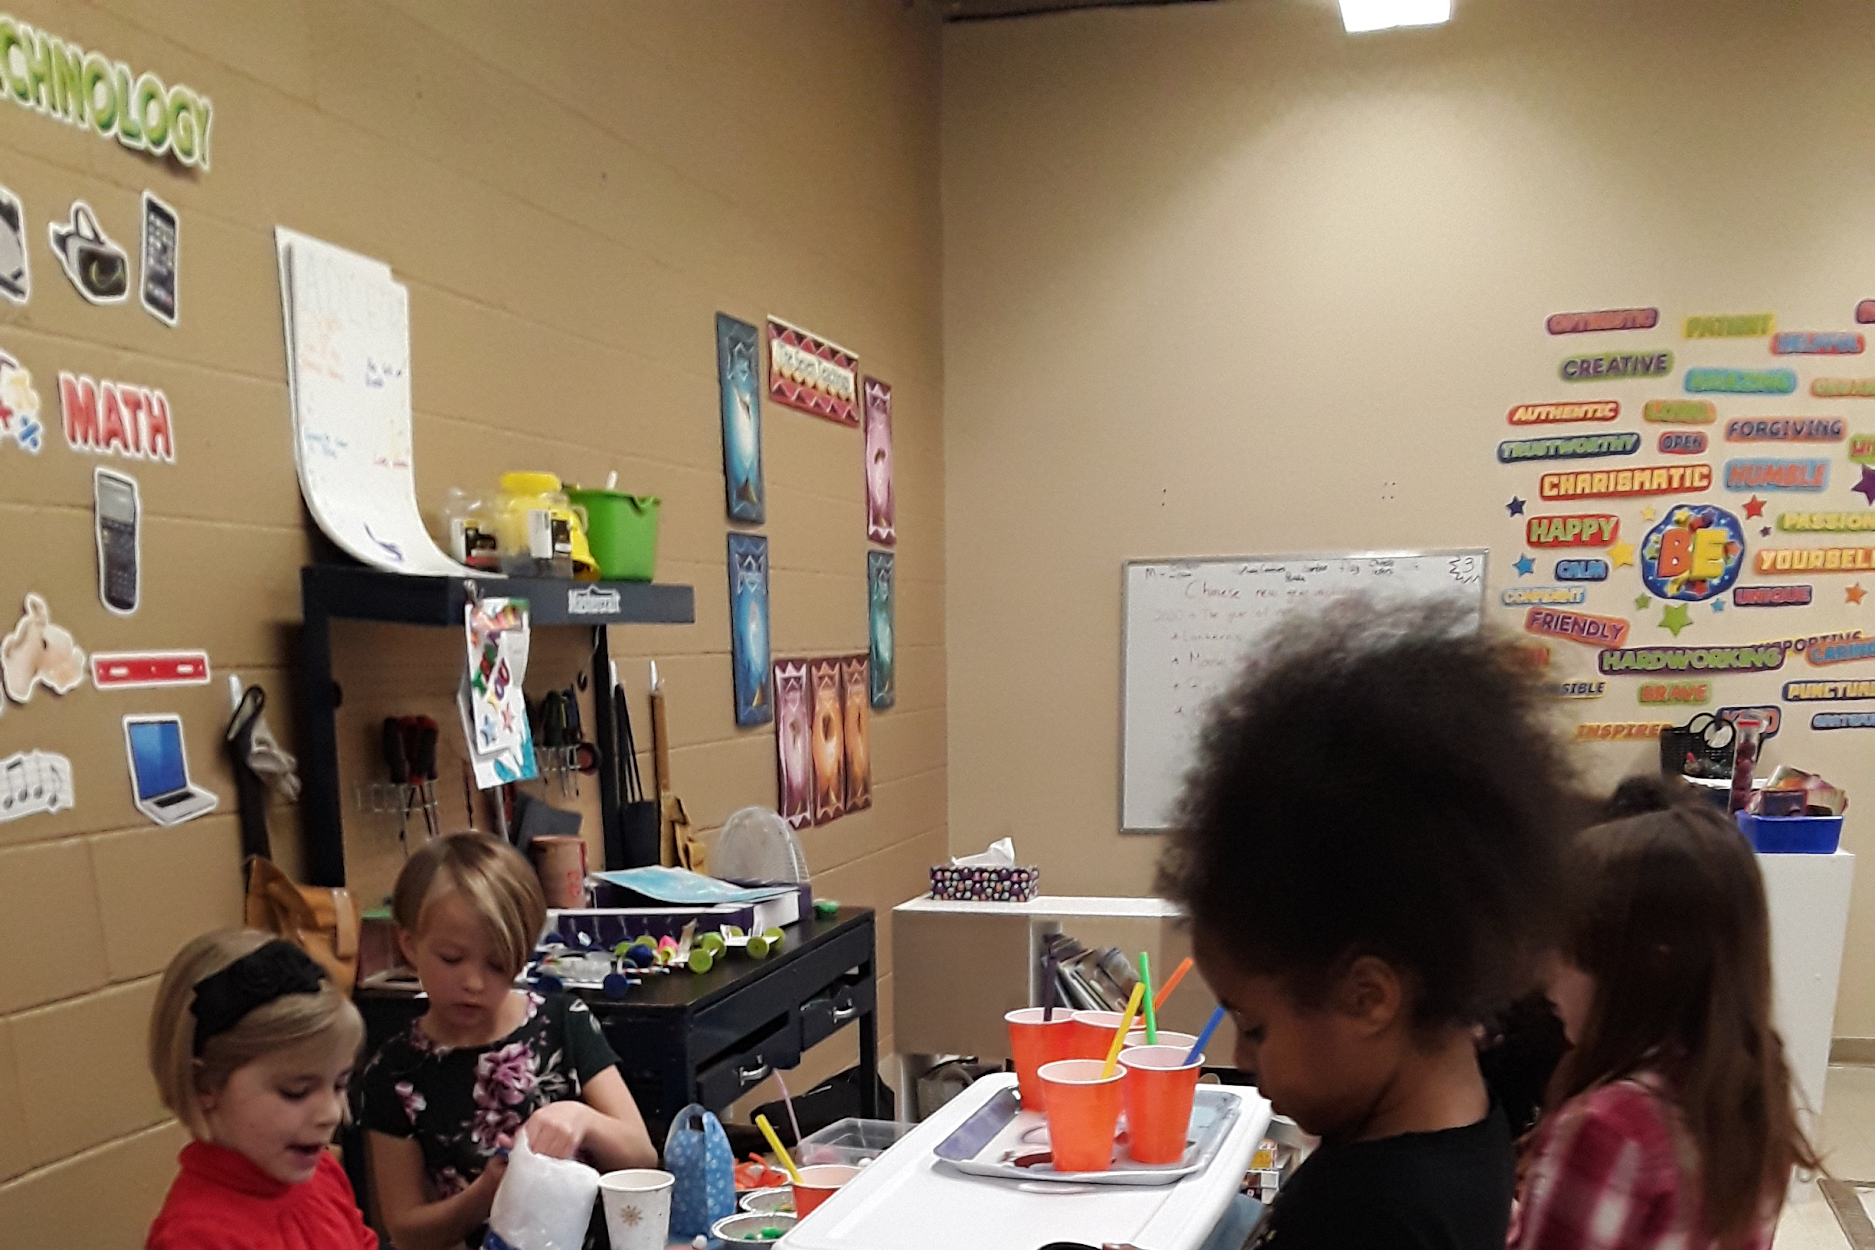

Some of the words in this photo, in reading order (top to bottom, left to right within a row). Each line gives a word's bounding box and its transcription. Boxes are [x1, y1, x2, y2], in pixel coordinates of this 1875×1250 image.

[0, 18, 210, 168] CHNOLOGY
[1562, 354, 1669, 380] CREATIVE
[60, 374, 172, 459] MATH
[1512, 401, 1617, 422] AUTHENTIC
[1728, 419, 1842, 439] FORGIVING
[1662, 435, 1703, 450] OPEN
[1541, 467, 1711, 497] CHARISMATIC
[1728, 463, 1826, 487] HUMBLE
[1529, 517, 1619, 543] HAPPY
[1657, 528, 1729, 581] BE
[1760, 548, 1875, 571] YOURSEL
[1557, 561, 1607, 579] CALM
[1735, 586, 1811, 605] UNIQUE
[1529, 611, 1625, 641] FRIENDLY
[1602, 649, 1782, 672] HARDWORKING
[1641, 684, 1708, 703] BRAVE
